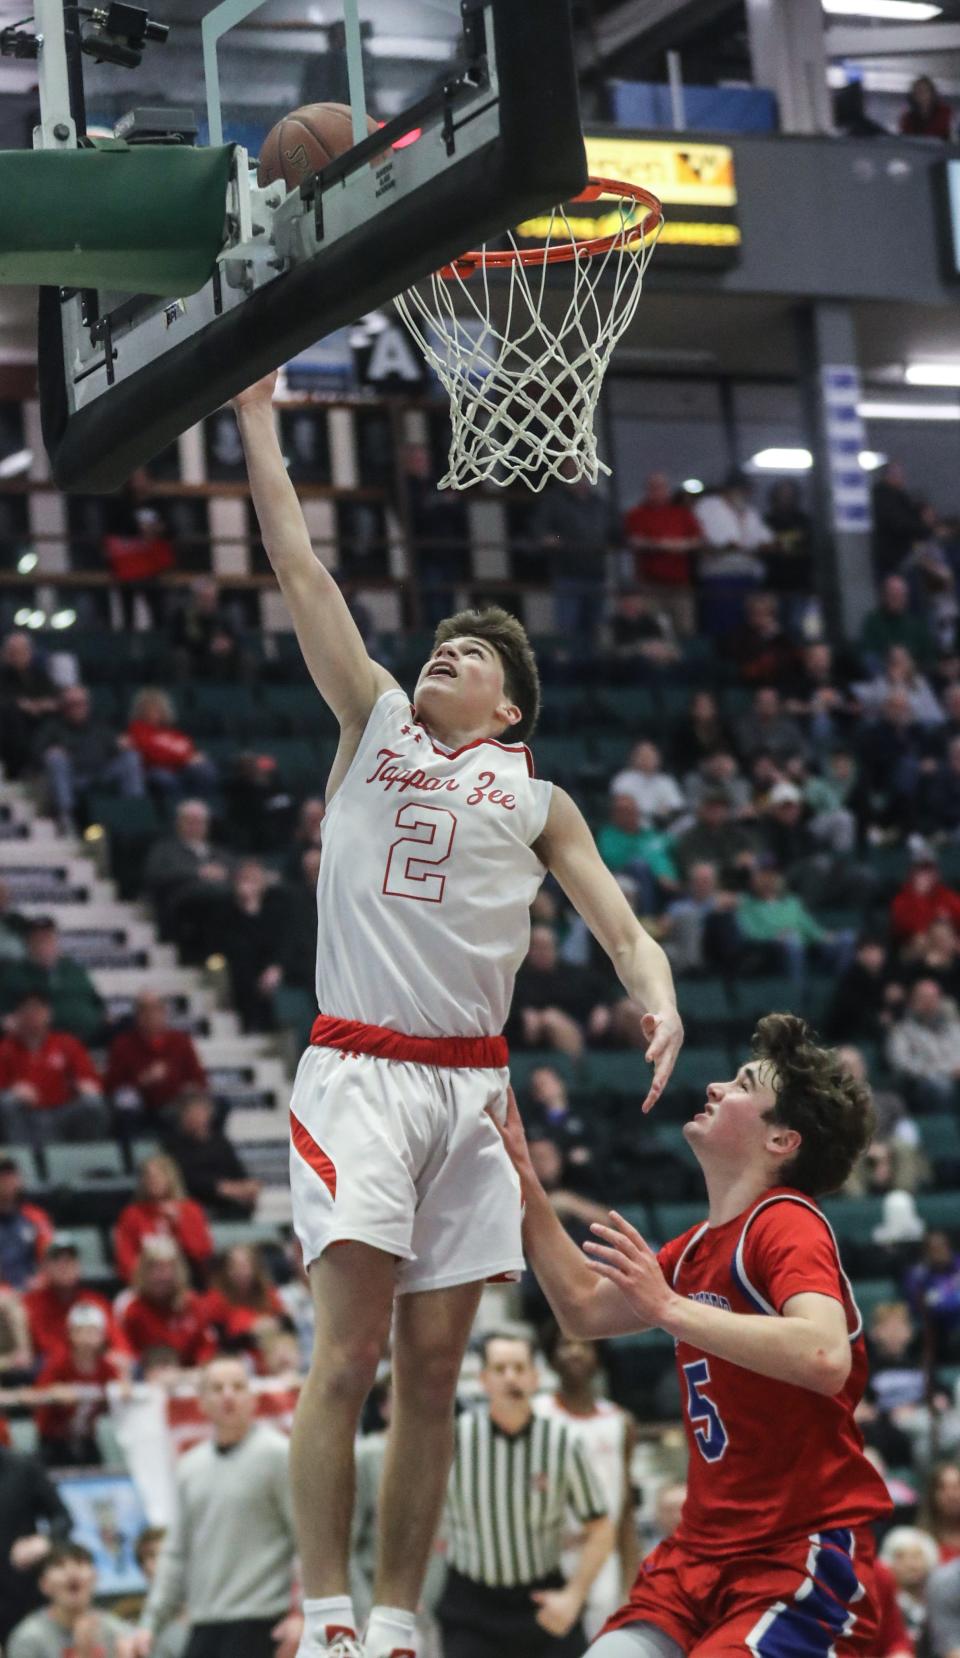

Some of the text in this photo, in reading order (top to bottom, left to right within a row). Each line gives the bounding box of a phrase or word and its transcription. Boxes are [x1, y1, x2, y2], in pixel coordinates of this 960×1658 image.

[466, 771, 516, 810] Zee
[382, 802, 458, 903] 2
[683, 1358, 729, 1463] 5
